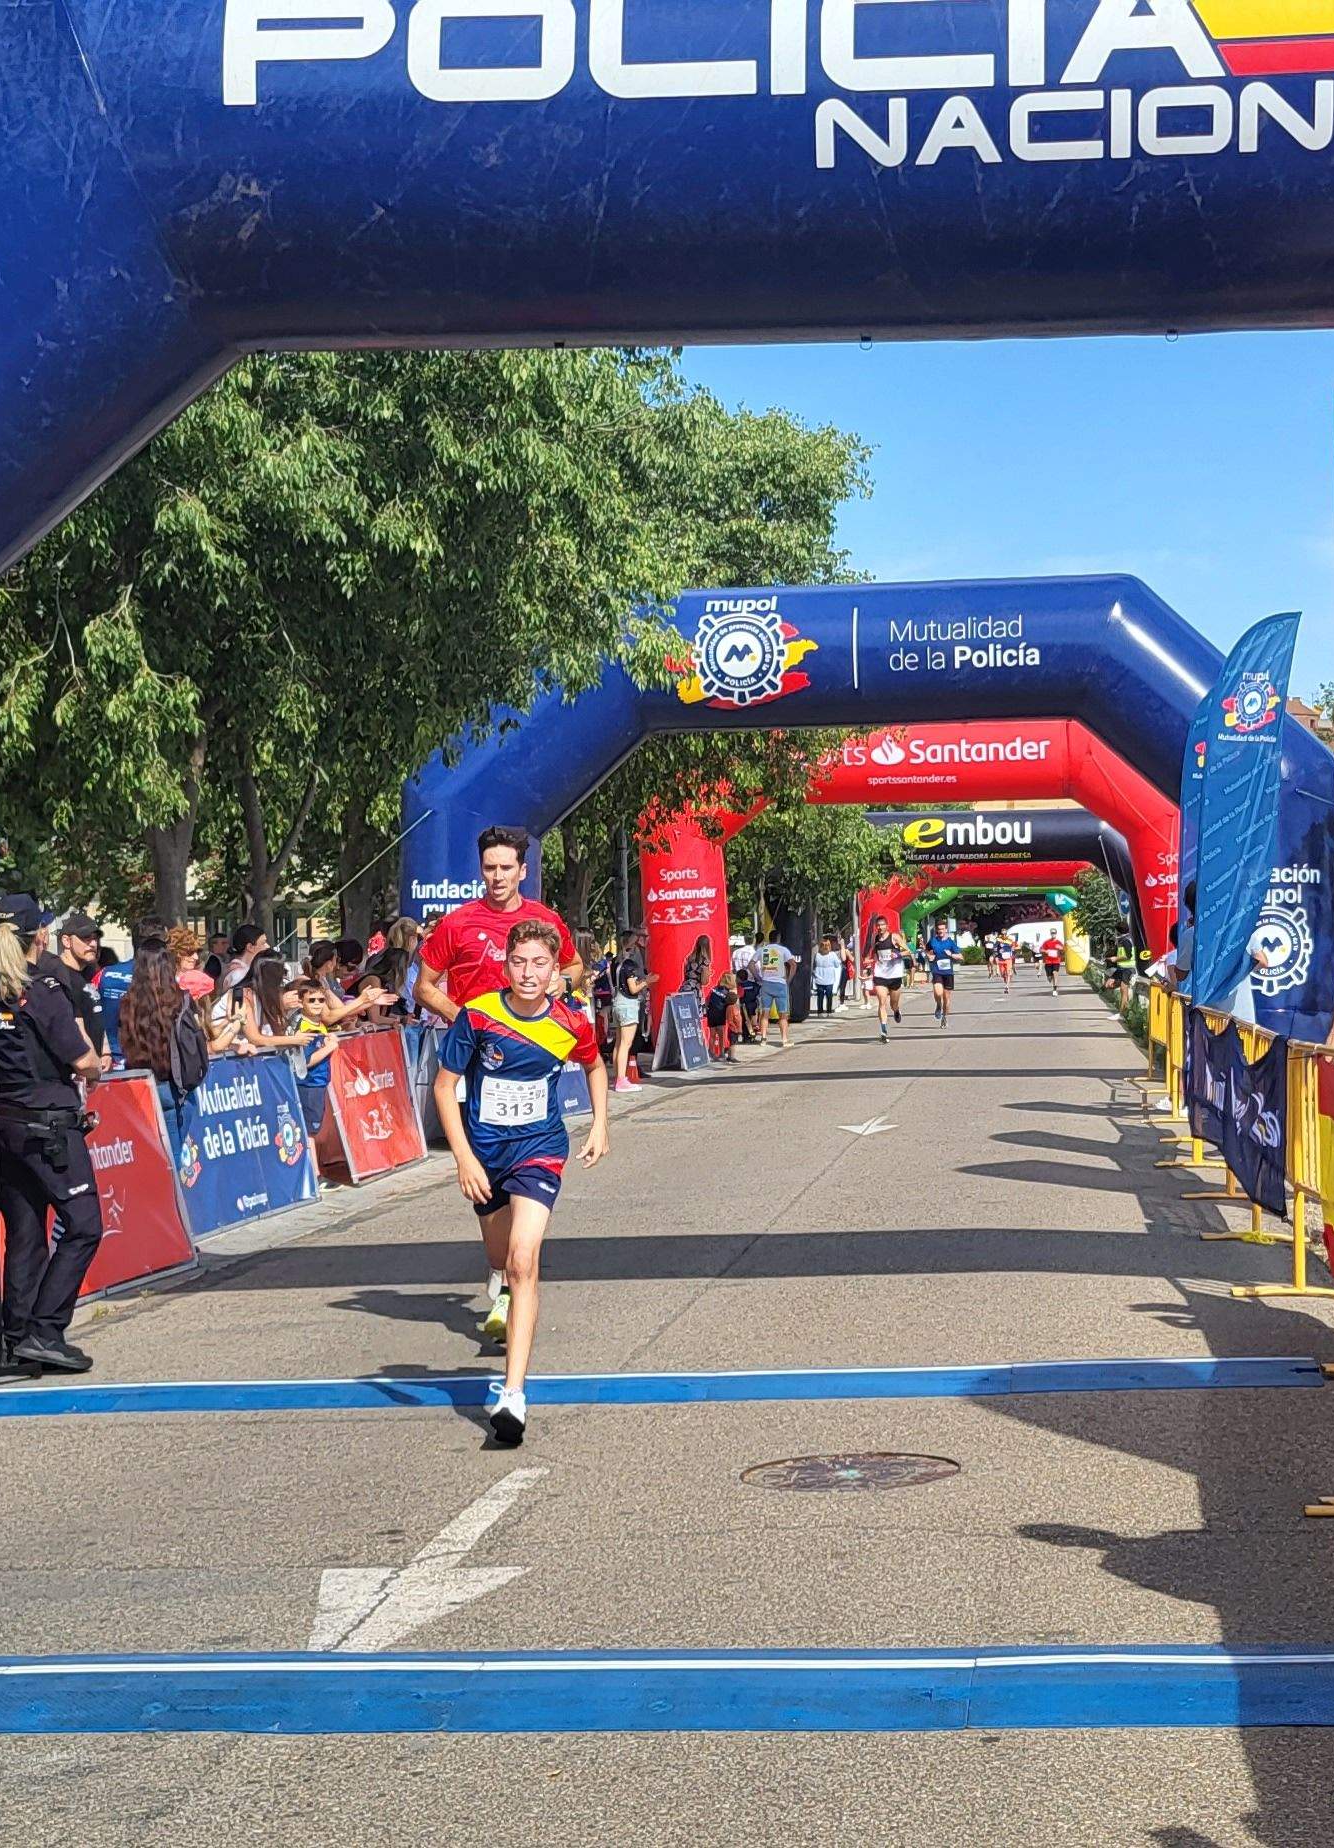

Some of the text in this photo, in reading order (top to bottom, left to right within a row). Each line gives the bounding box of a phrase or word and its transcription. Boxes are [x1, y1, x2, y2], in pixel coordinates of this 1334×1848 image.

[706, 596, 778, 613] mupol
[890, 614, 1023, 642] Mutualidad
[890, 642, 1040, 671] de la Policía
[909, 736, 1051, 764] Santander
[867, 774, 957, 786] sportssantander.es
[903, 815, 1032, 848] embou
[659, 868, 699, 883] Sports
[1270, 863, 1321, 884] ación
[411, 879, 487, 899] fundació
[658, 887, 717, 901] Santander
[1260, 966, 1286, 977] OLICÍA
[196, 1074, 263, 1117] Mutualidad
[496, 1102, 534, 1116] 313
[203, 1115, 270, 1160] de la Polcía
[89, 1136, 134, 1170] ntander
